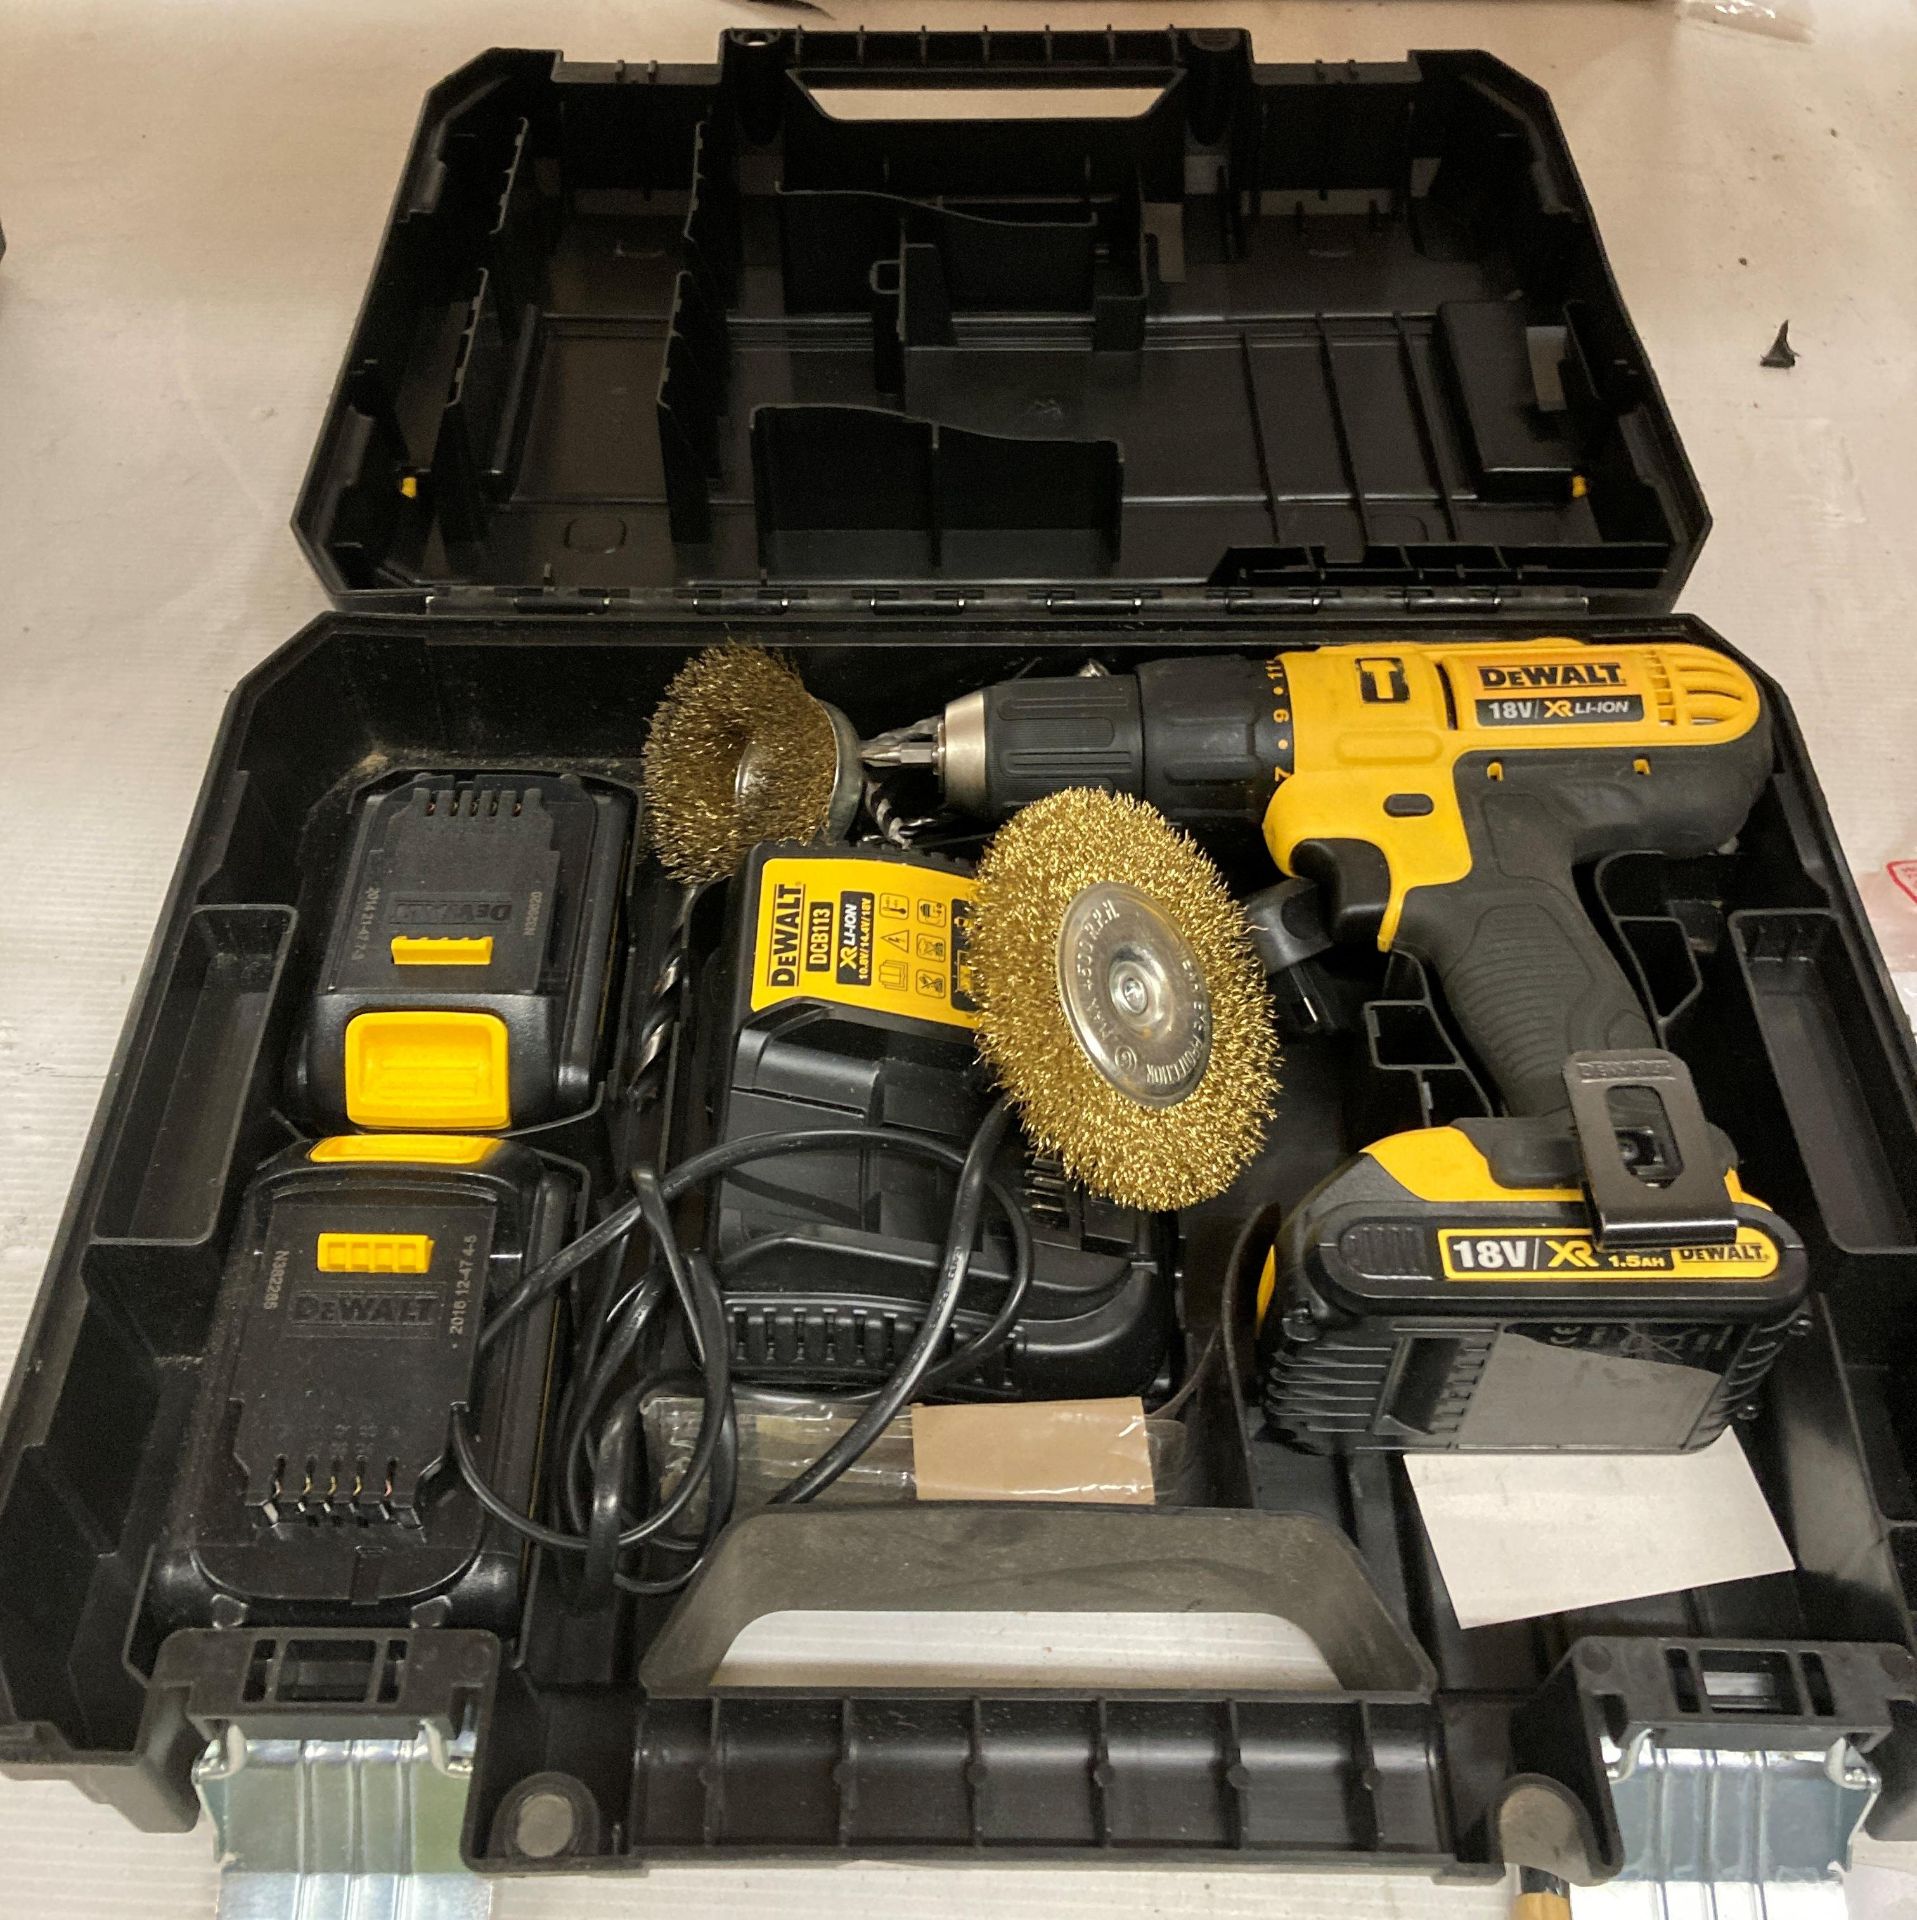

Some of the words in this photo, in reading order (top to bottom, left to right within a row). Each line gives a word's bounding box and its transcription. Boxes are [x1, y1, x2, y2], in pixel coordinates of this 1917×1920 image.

[1273, 708, 1290, 723] 9
[1489, 701, 1532, 720] 18V
[1543, 700, 1574, 719] XR
[1575, 700, 1629, 715] LI-ION
[1274, 766, 1291, 782] 7
[810, 908, 831, 964] DCB113
[843, 904, 858, 946] LI-ION
[840, 946, 858, 969] XR
[1453, 1240, 1528, 1269] 18V
[1545, 1240, 1599, 1268] XR
